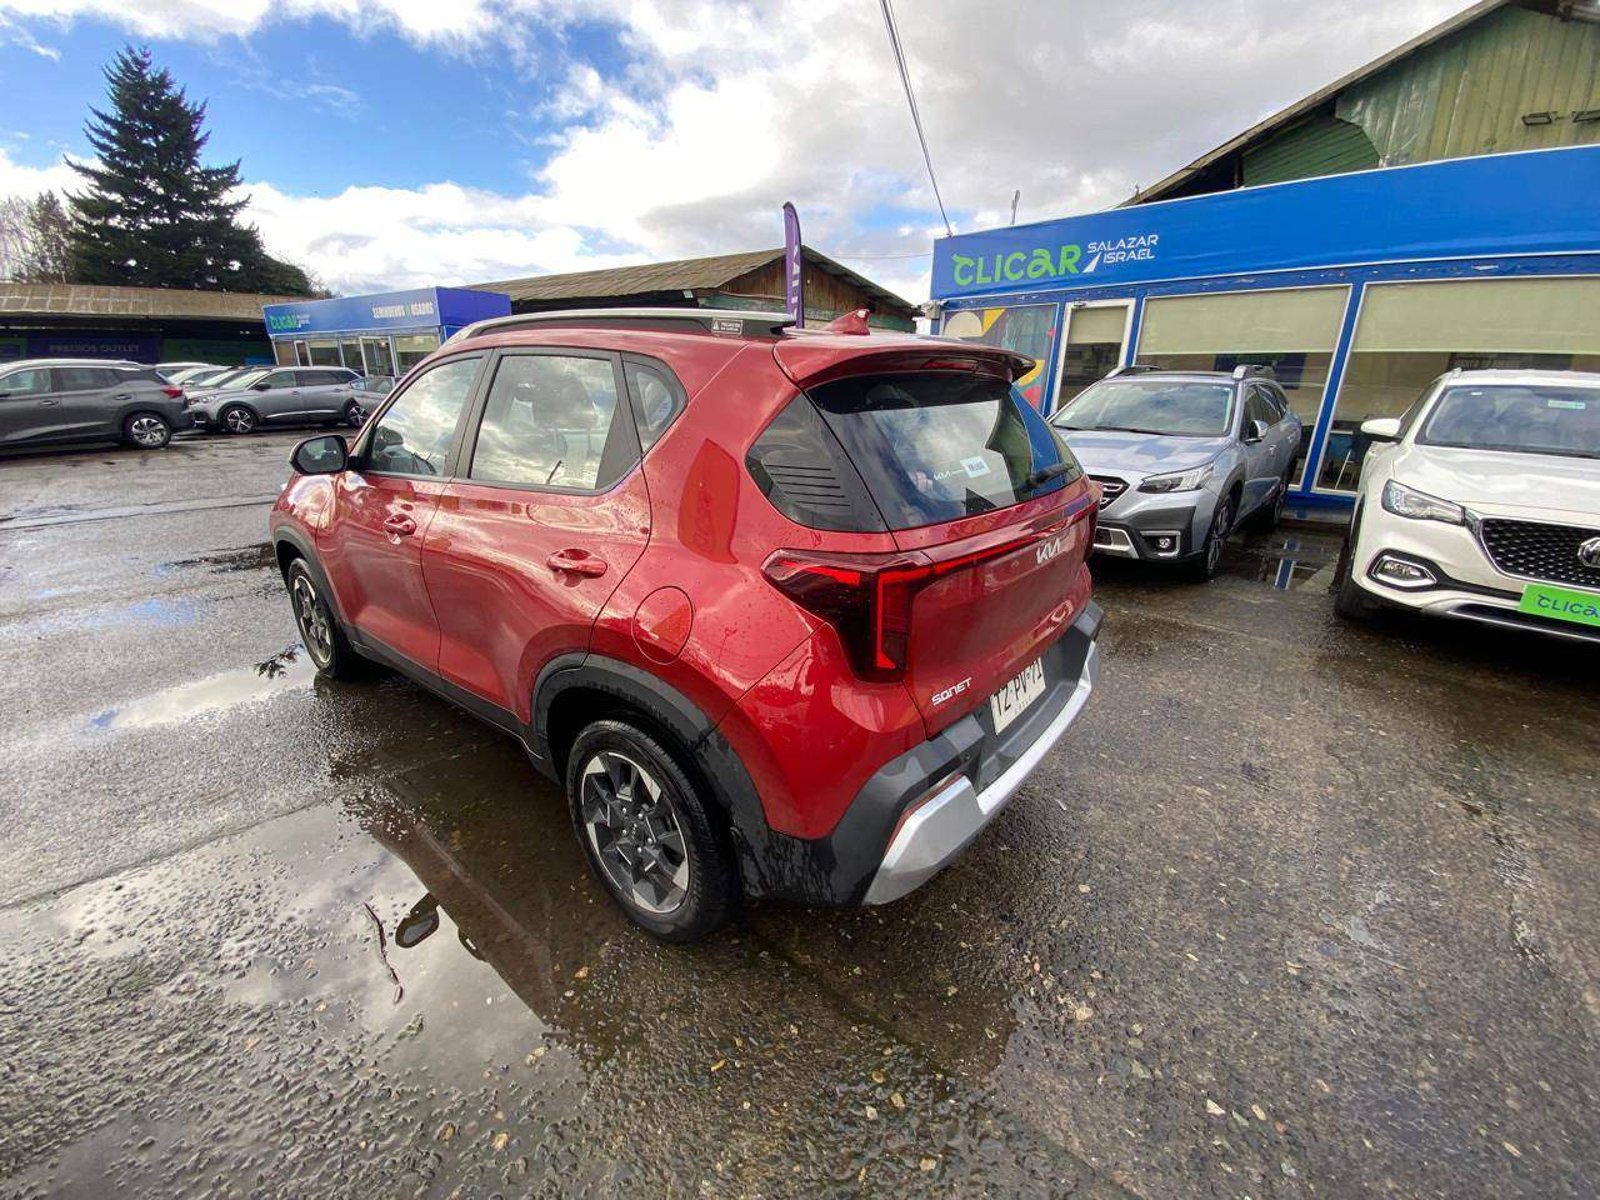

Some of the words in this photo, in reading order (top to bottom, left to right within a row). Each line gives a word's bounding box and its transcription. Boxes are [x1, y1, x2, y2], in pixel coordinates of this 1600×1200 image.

[1087, 234, 1159, 254] SALAZAR
[1103, 248, 1155, 264] ISRAEL
[100, 344, 139, 352] OUTLET
[931, 676, 973, 706] SONET
